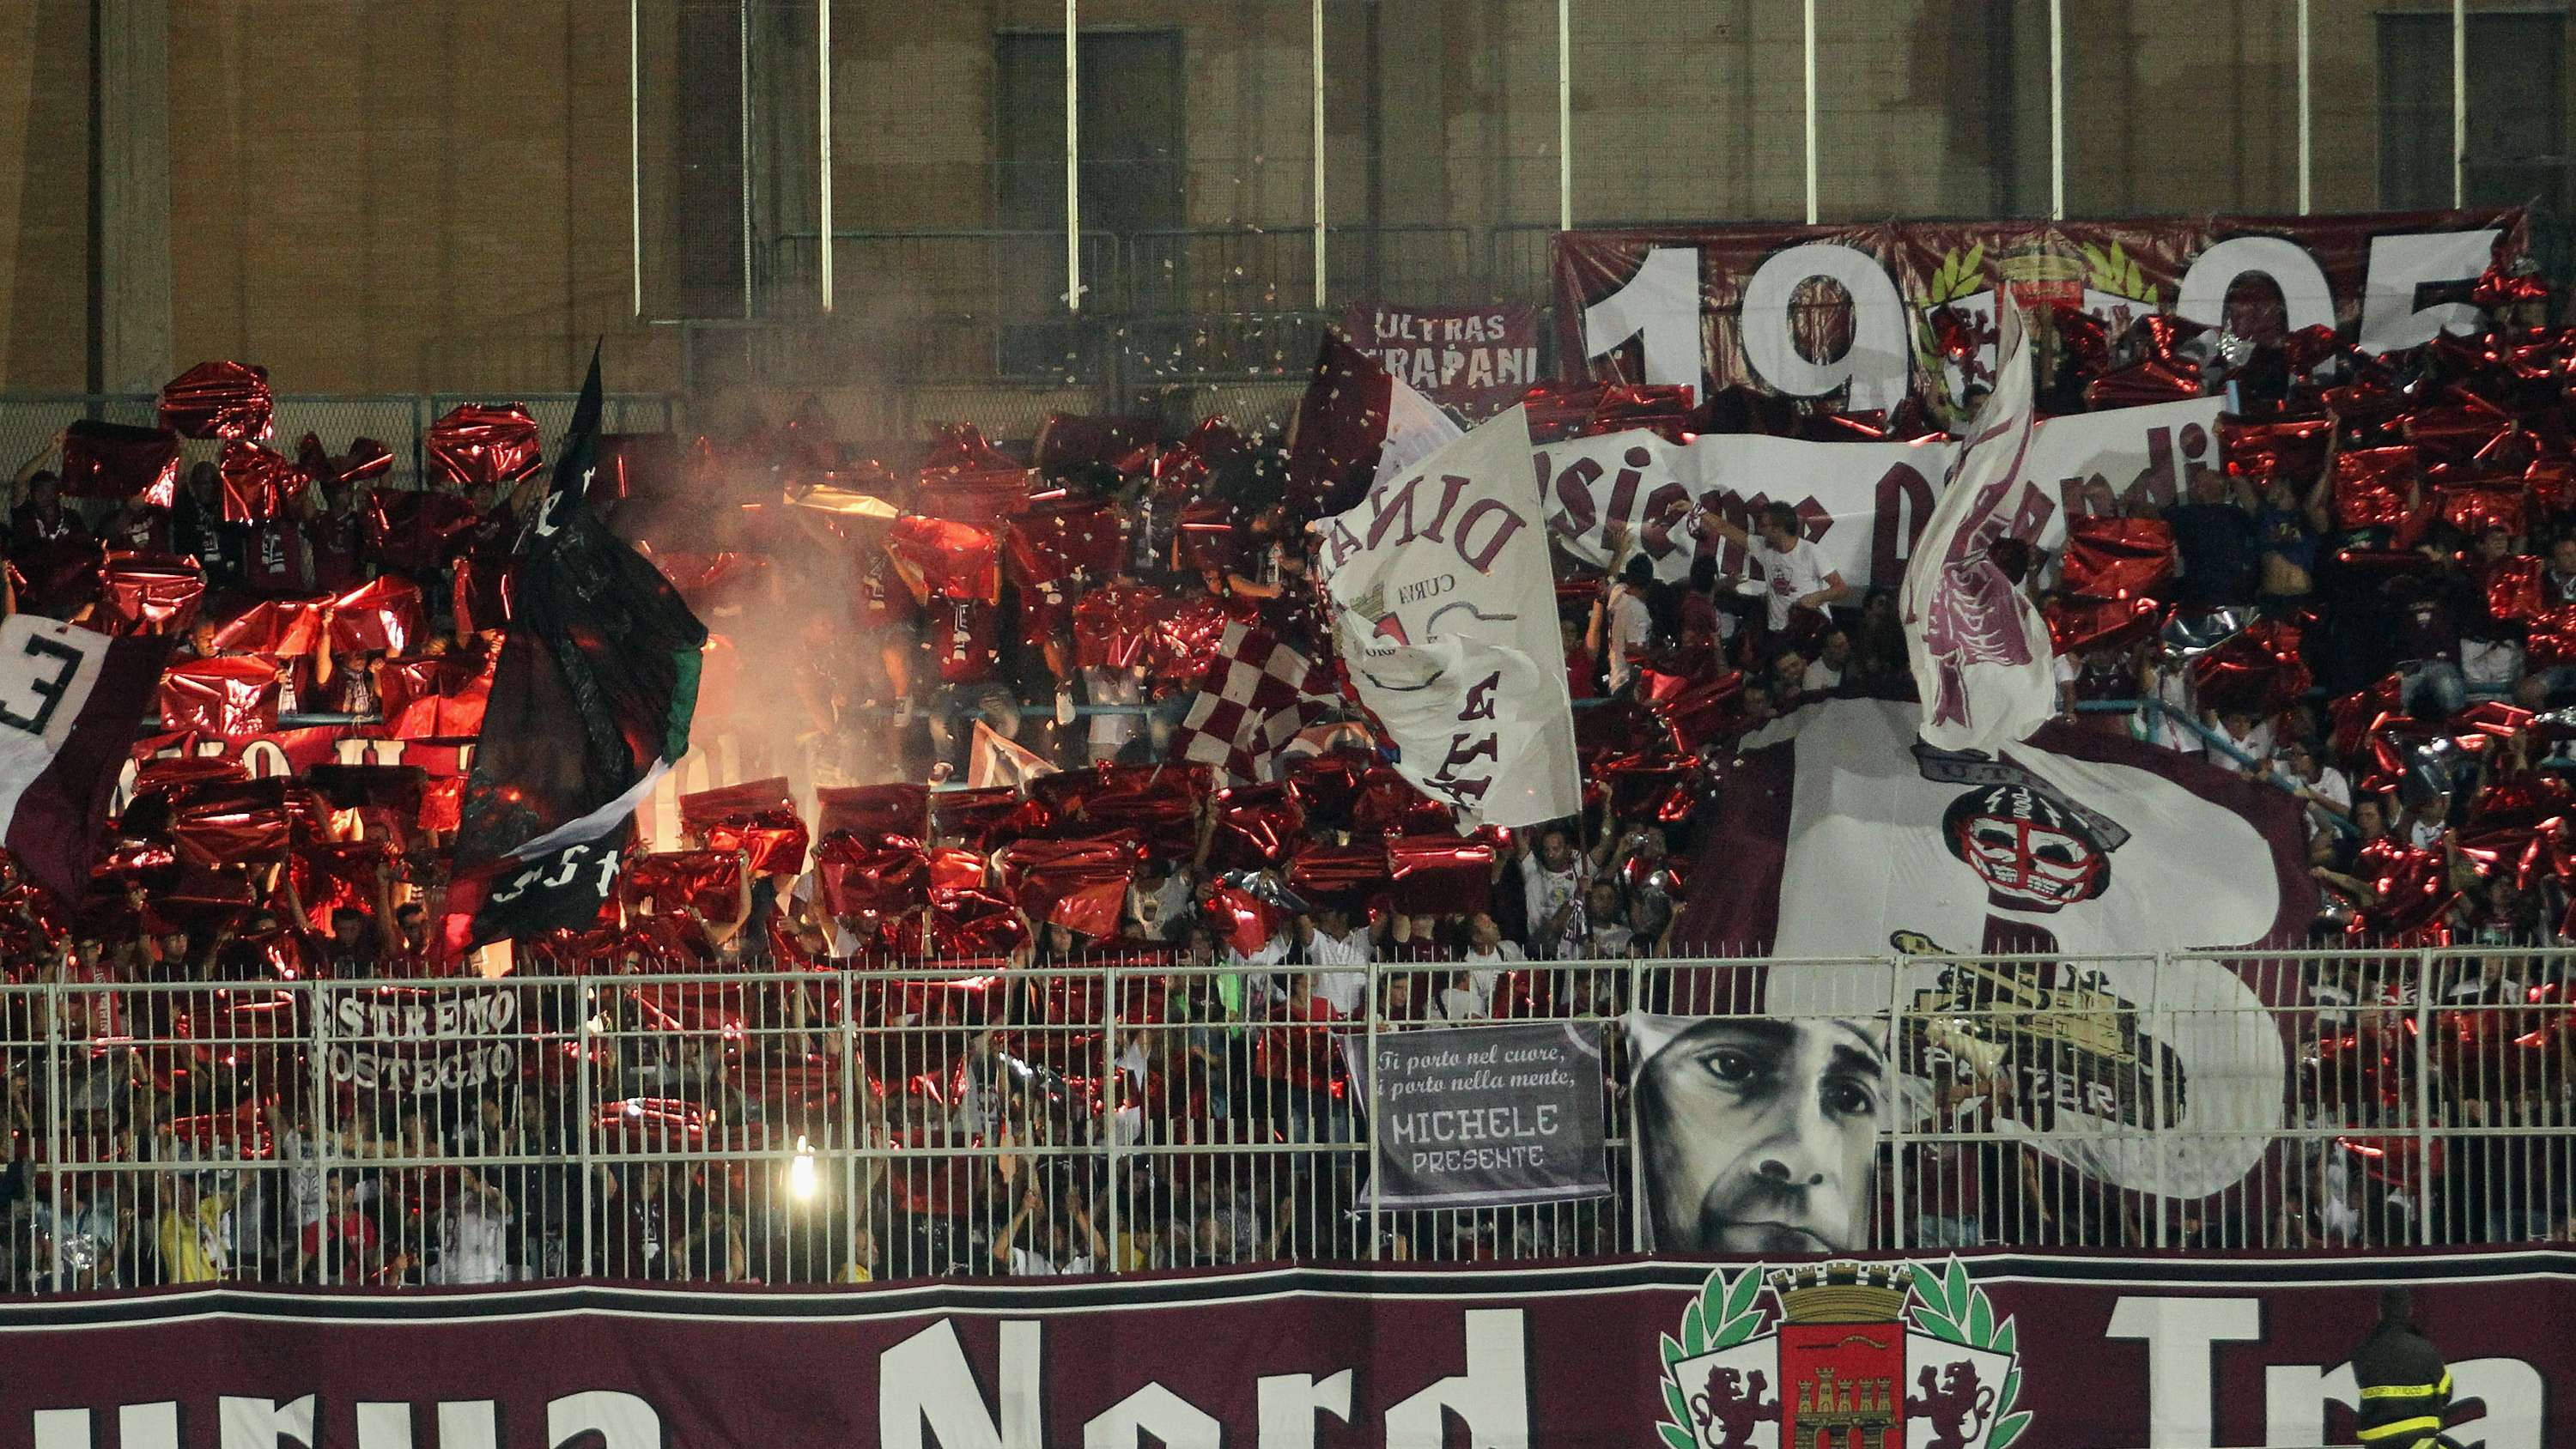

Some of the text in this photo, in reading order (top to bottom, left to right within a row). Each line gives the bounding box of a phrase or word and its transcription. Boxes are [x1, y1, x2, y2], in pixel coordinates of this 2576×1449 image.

[1375, 312, 1505, 342] ULTRAS
[1377, 1045, 1565, 1074] Ti porto nel cuore,
[1390, 1076, 1443, 1100] porto
[1449, 1070, 1504, 1091] nella
[1510, 1069, 1575, 1088] mente,
[1923, 1046, 2115, 1113] PAZER
[1392, 1104, 1558, 1144] MICHELE
[1413, 1146, 1544, 1174] PRESENTE
